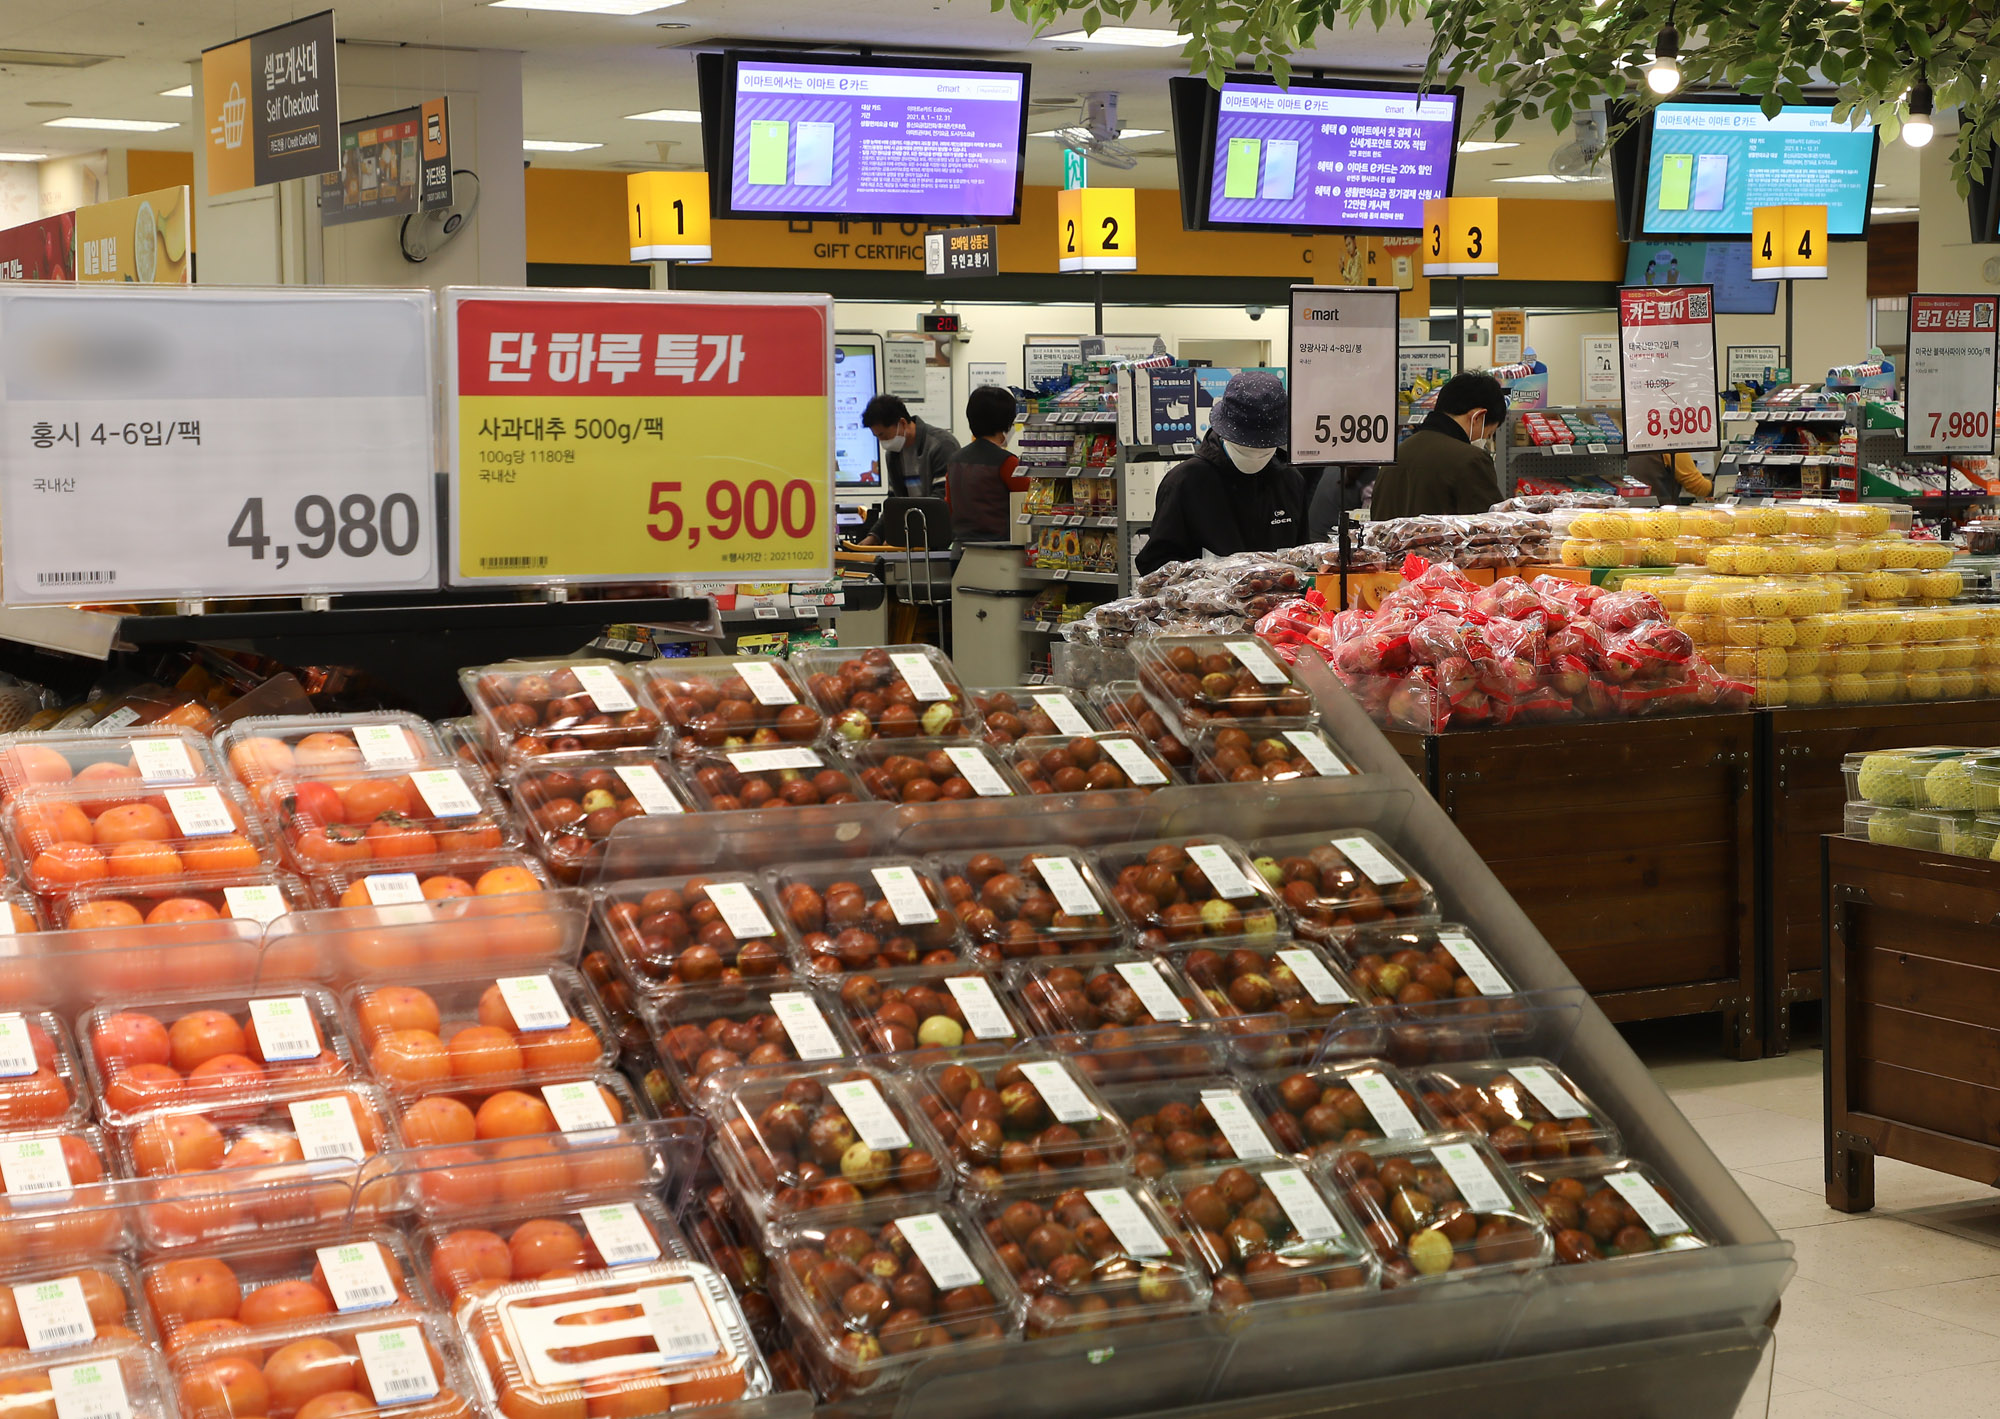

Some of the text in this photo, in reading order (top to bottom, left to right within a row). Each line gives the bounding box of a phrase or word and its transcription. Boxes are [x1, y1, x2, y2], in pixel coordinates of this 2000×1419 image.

[264, 40, 318, 91] 셀프계산대
[744, 75, 803, 89] 이마트에서는
[806, 77, 835, 90] 이마트
[937, 84, 960, 94] emart
[266, 89, 319, 122] Self Checkout
[1225, 96, 1274, 109] 이마트에서는
[1277, 98, 1301, 109] 이마트
[1385, 105, 1405, 114] emart
[1660, 115, 1706, 127] 이마트에서는
[1708, 116, 1731, 127] 이마트
[1809, 119, 1828, 128] emart
[1320, 123, 1338, 135] 혜택
[1351, 125, 1387, 137] 이마트에서
[1388, 126, 1396, 137] 첫
[1413, 127, 1421, 138] 시
[270, 139, 284, 152] 카드전용
[1349, 137, 1427, 151] 신세계포인트 50% 적립
[1317, 161, 1333, 173] 혜택
[1347, 162, 1369, 173] 이마트
[1399, 165, 1416, 175] 20%
[1418, 164, 1432, 176] 할인
[1314, 185, 1331, 197] 혜택
[1433, 189, 1441, 200] 시
[1343, 199, 1391, 211] 12만원 캐시백
[636, 203, 642, 239] 1
[673, 199, 684, 235] 1
[1067, 219, 1075, 253] 2
[1101, 216, 1119, 250] 2
[1432, 224, 1441, 257] 3
[951, 234, 989, 250] 모바일 상품권
[1467, 226, 1482, 258] 3
[1762, 231, 1773, 260] 4
[1798, 229, 1812, 260] 4
[814, 243, 850, 259] GIFT
[951, 251, 990, 270] 무인교환기
[1303, 308, 1339, 321] emart
[1630, 302, 1684, 321] 카드 행사
[1917, 310, 1971, 328] 광고 상품
[1300, 343, 1328, 353] 양광사과
[1915, 347, 1932, 356] 미국산
[488, 331, 746, 384] 단 하루 특가
[478, 416, 664, 444] 사과대추 500g/팩
[1314, 414, 1389, 448] 5,980
[1647, 405, 1712, 440] 8,980
[1928, 411, 1989, 442] 7,980
[30, 419, 201, 449] 홍시 4-6입/팩
[478, 449, 575, 466] 100g당 1180원
[478, 469, 517, 484] 국내산
[32, 477, 76, 494] 국내산
[646, 479, 816, 550] 5,900
[227, 492, 420, 571] 4,980
[769, 550, 814, 562] 20211020
